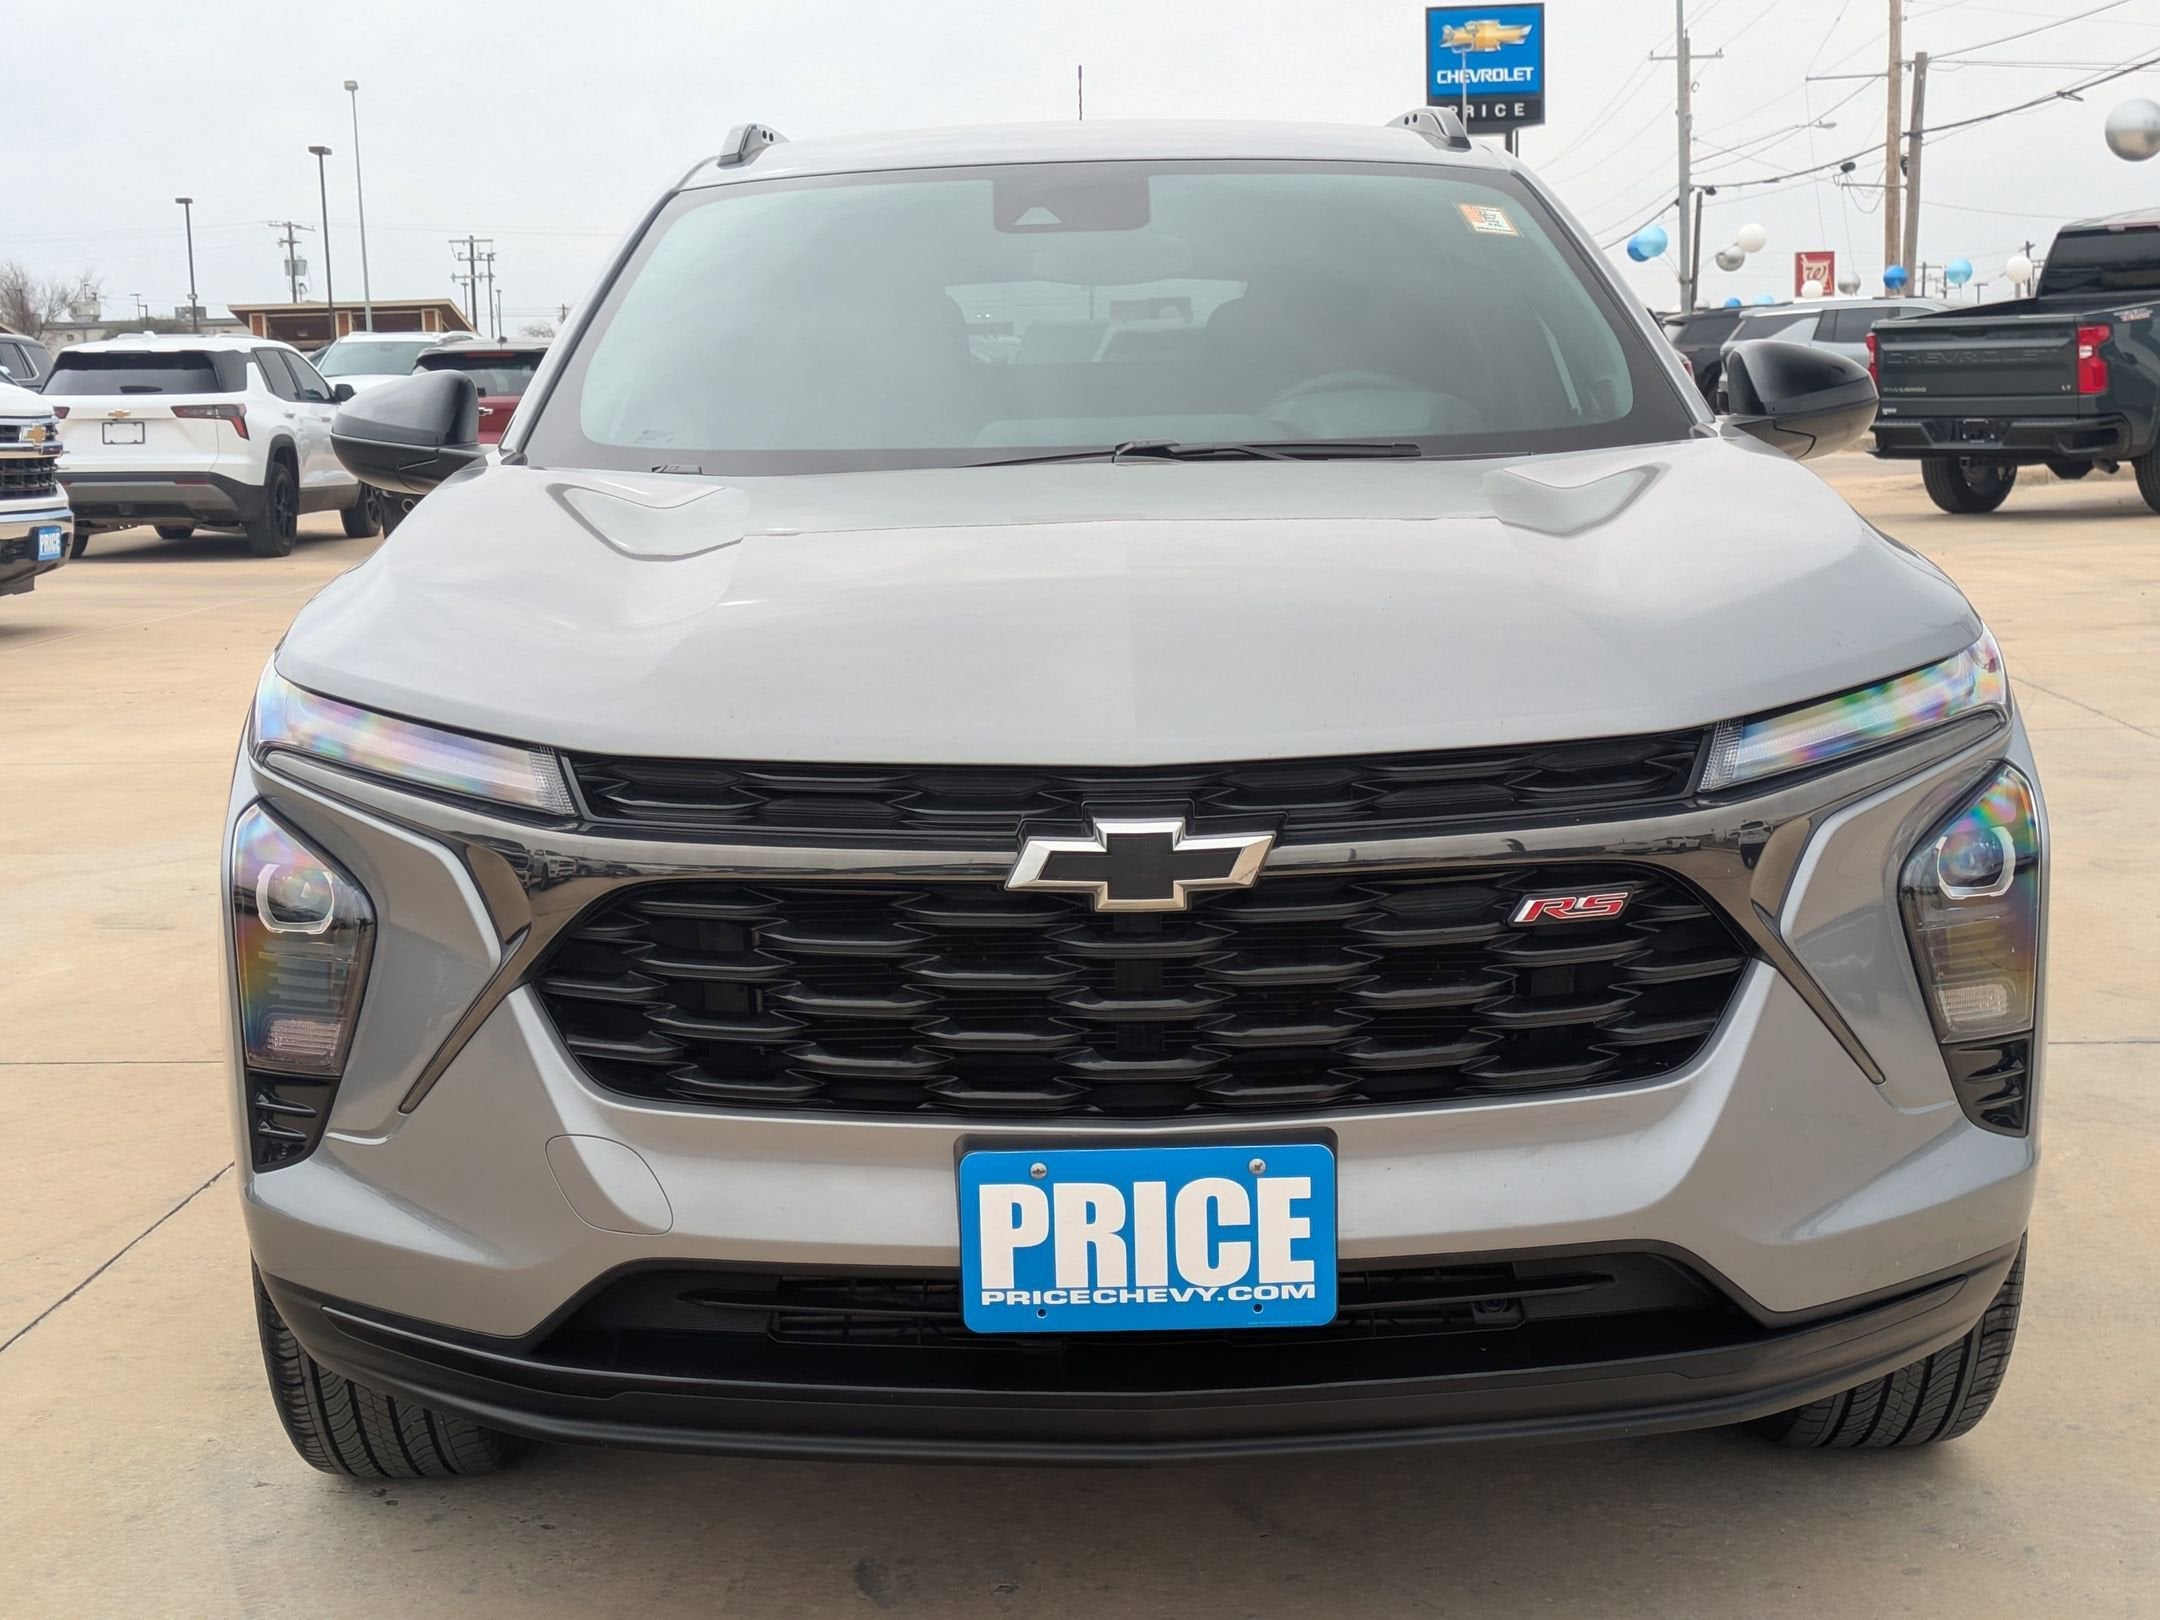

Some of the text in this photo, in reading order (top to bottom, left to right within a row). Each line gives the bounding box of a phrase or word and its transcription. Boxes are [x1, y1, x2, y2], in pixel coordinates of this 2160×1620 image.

[1437, 67, 1534, 84] CHEVROLET
[1887, 349, 2060, 365] CHEVROLET
[1514, 892, 1628, 922] RS
[979, 1177, 1315, 1289] PRICE
[981, 1284, 1316, 1306] PRICECHEVY.COM
